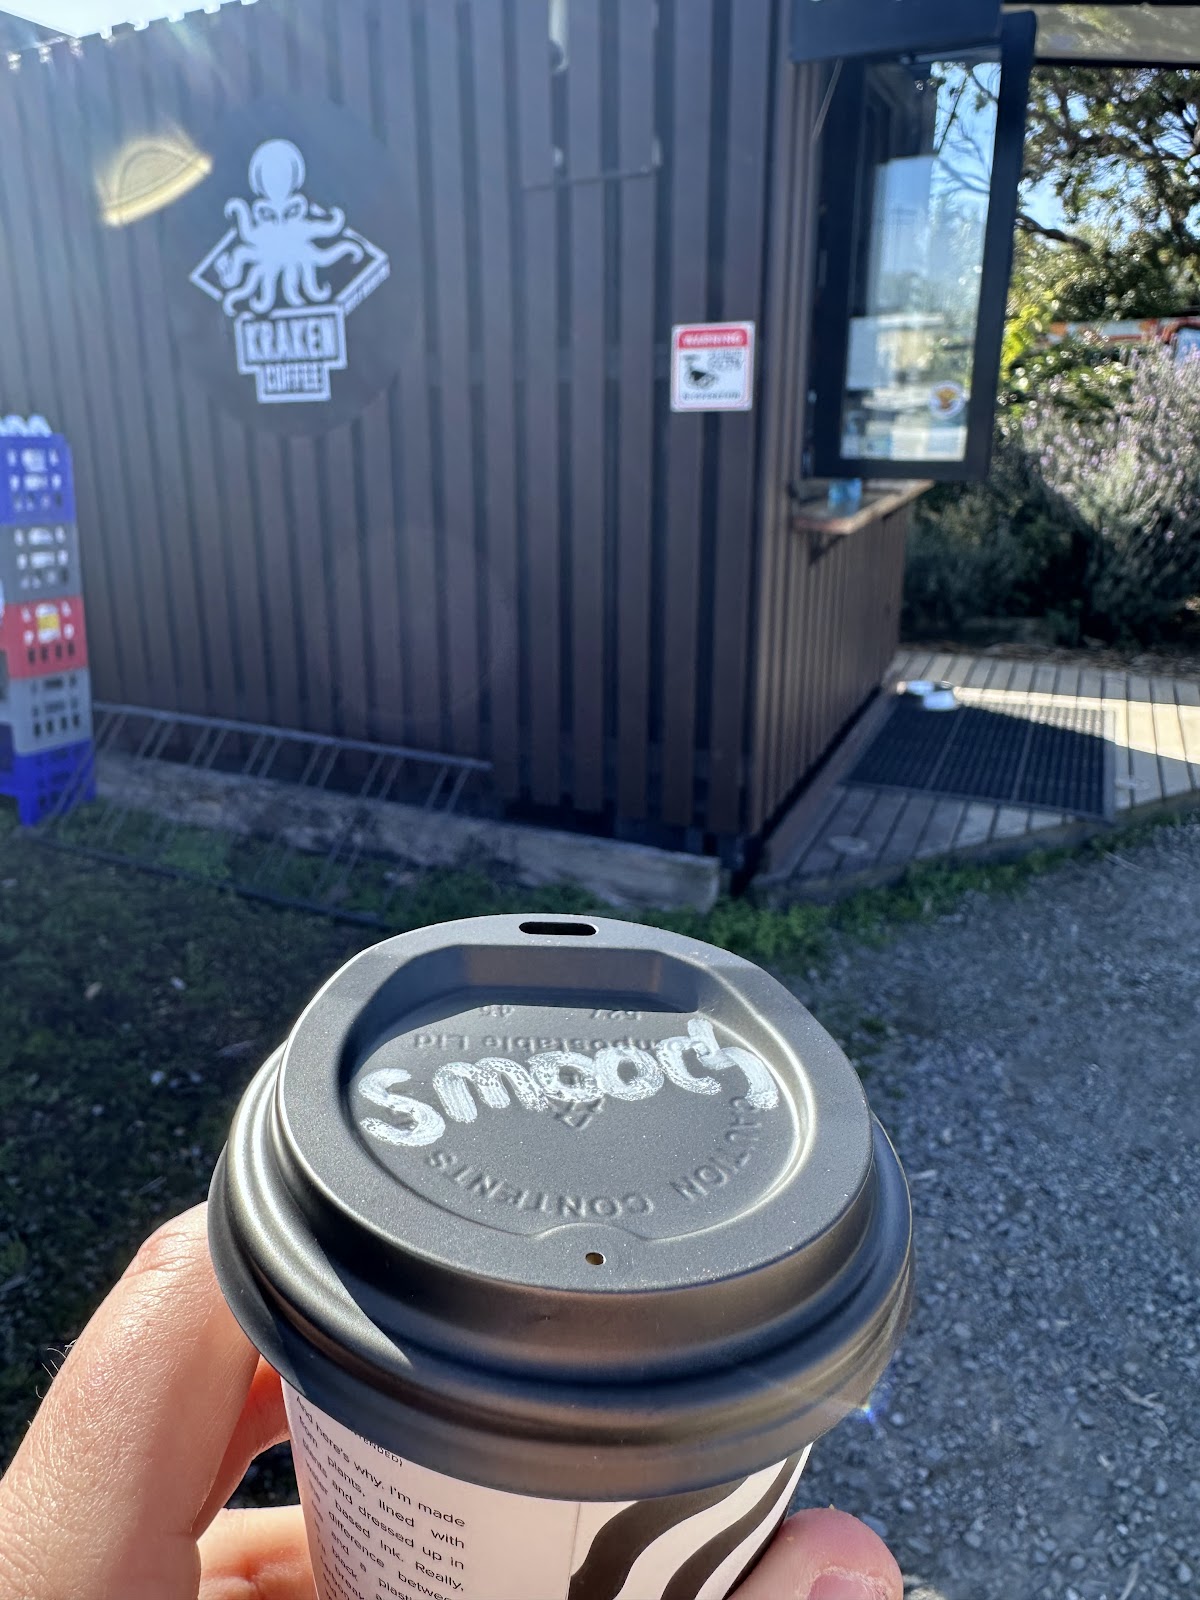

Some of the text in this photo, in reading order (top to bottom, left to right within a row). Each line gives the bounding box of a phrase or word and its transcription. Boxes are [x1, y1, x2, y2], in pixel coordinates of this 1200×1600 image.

[427, 1149, 655, 1219] CONTENTS
[316, 1421, 351, 1463] here's
[353, 1461, 385, 1490] why.
[390, 1485, 411, 1506] I'm
[418, 1502, 466, 1527] made
[327, 1455, 366, 1497] plants,
[379, 1498, 415, 1528] lined
[430, 1528, 465, 1549] with
[328, 1510, 385, 1569] difference
[398, 1570, 452, 1600] betwe
[331, 1531, 350, 1556] and
[360, 1562, 367, 1573] a
[332, 1479, 353, 1505] and
[358, 1505, 414, 1548] dressed
[422, 1546, 442, 1561] up
[450, 1556, 464, 1570] in
[332, 1544, 358, 1582] black
[334, 1499, 371, 1539] based
[415, 1560, 464, 1592] Really,
